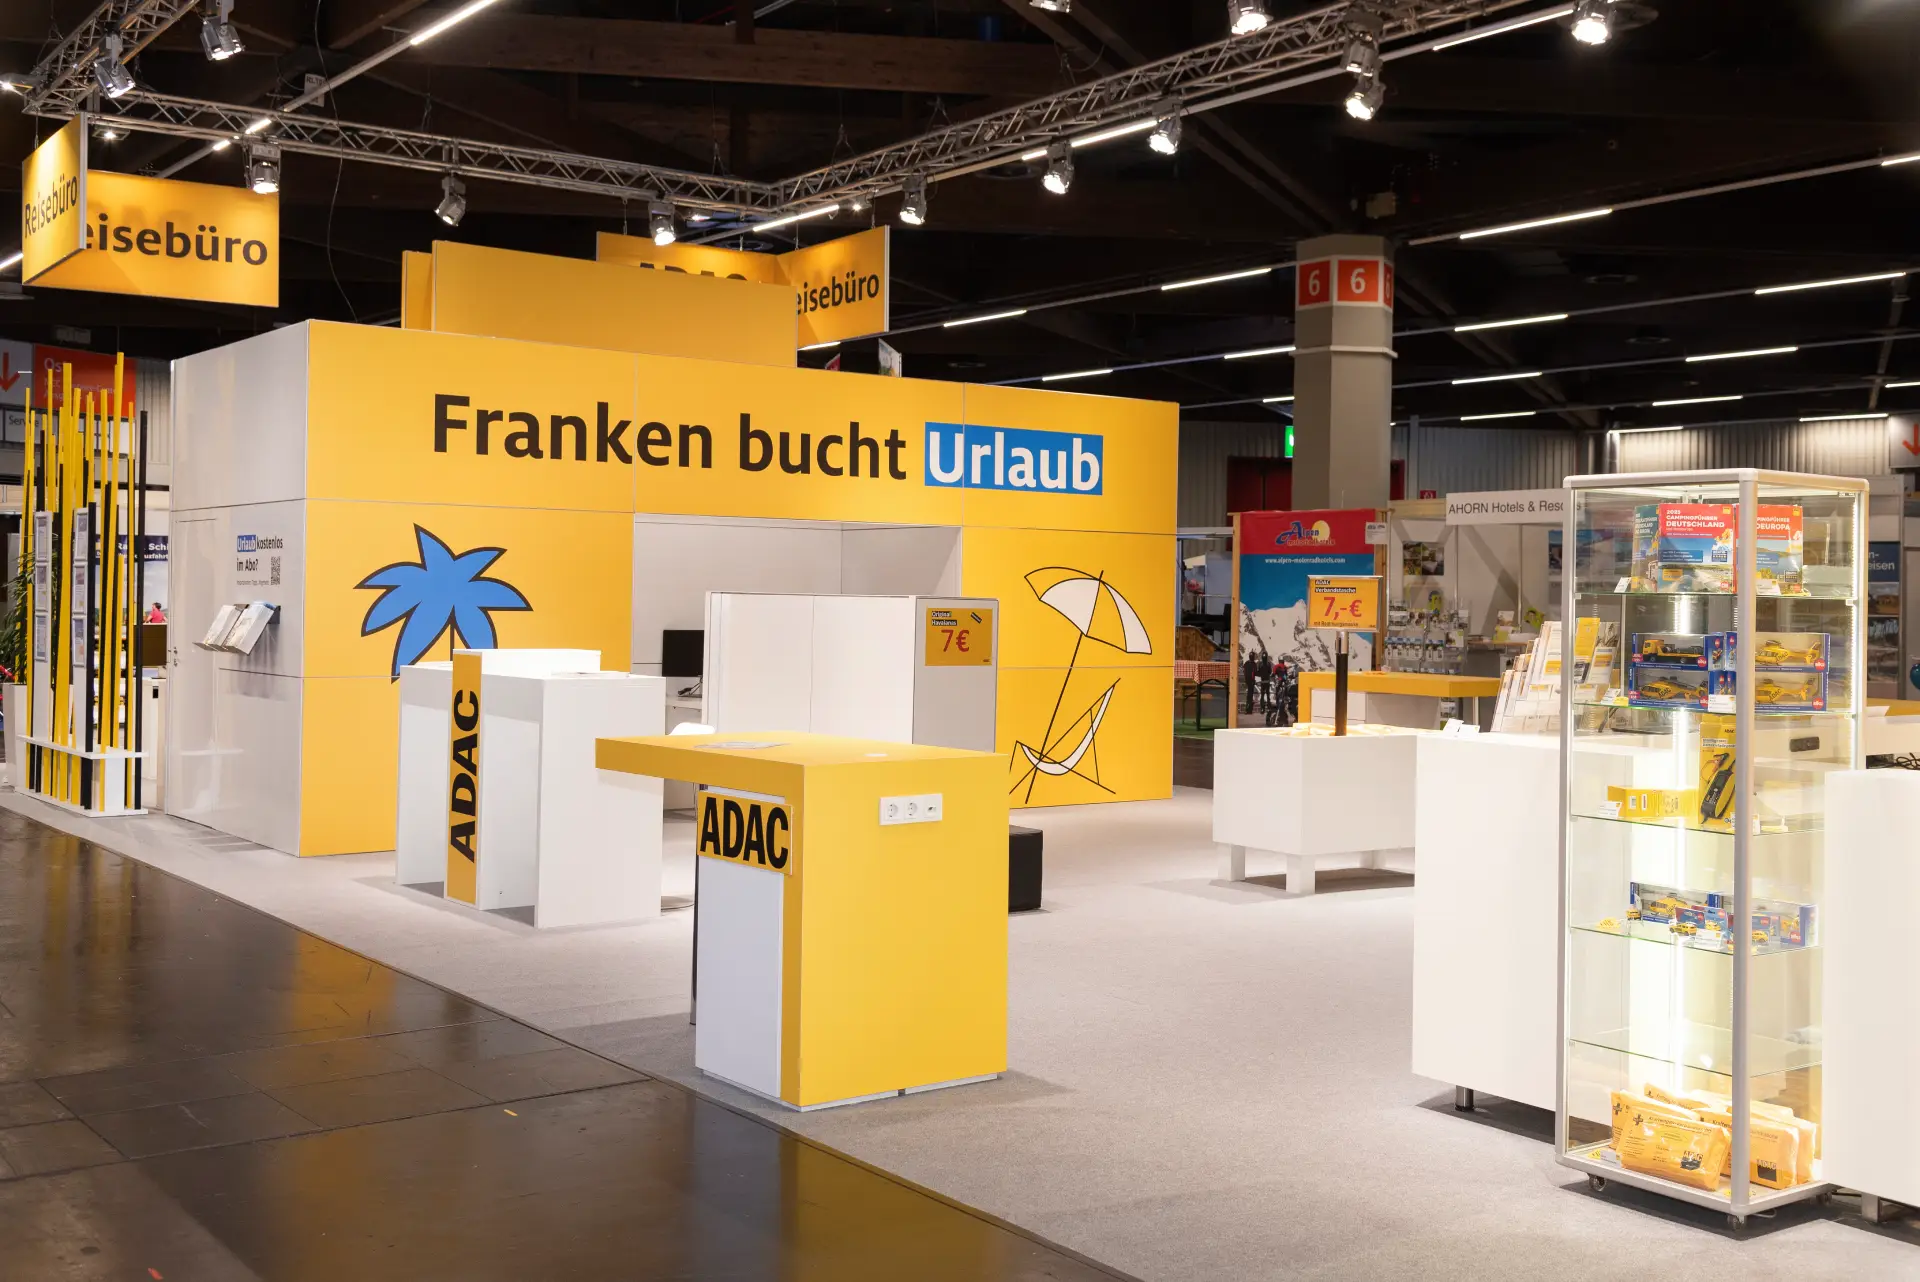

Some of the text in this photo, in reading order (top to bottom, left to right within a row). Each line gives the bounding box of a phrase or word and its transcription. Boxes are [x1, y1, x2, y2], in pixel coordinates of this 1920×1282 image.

[25, 173, 78, 239] Reisebüro
[1308, 269, 1320, 296] 6
[1350, 267, 1366, 294] 6
[9, 415, 39, 428] Serve
[434, 393, 1100, 491] Franken bucht Urlaub
[1449, 502, 1489, 514] AHORN
[1492, 501, 1525, 513] Hotels
[1527, 500, 1536, 512] &
[256, 536, 283, 550] kostenlos
[1276, 520, 1320, 545] Alpen
[245, 557, 258, 571] Abo?
[1265, 556, 1346, 565] www.alpen-motorradhotels.com
[450, 689, 480, 863] ADAC
[699, 796, 789, 869] ADAC
